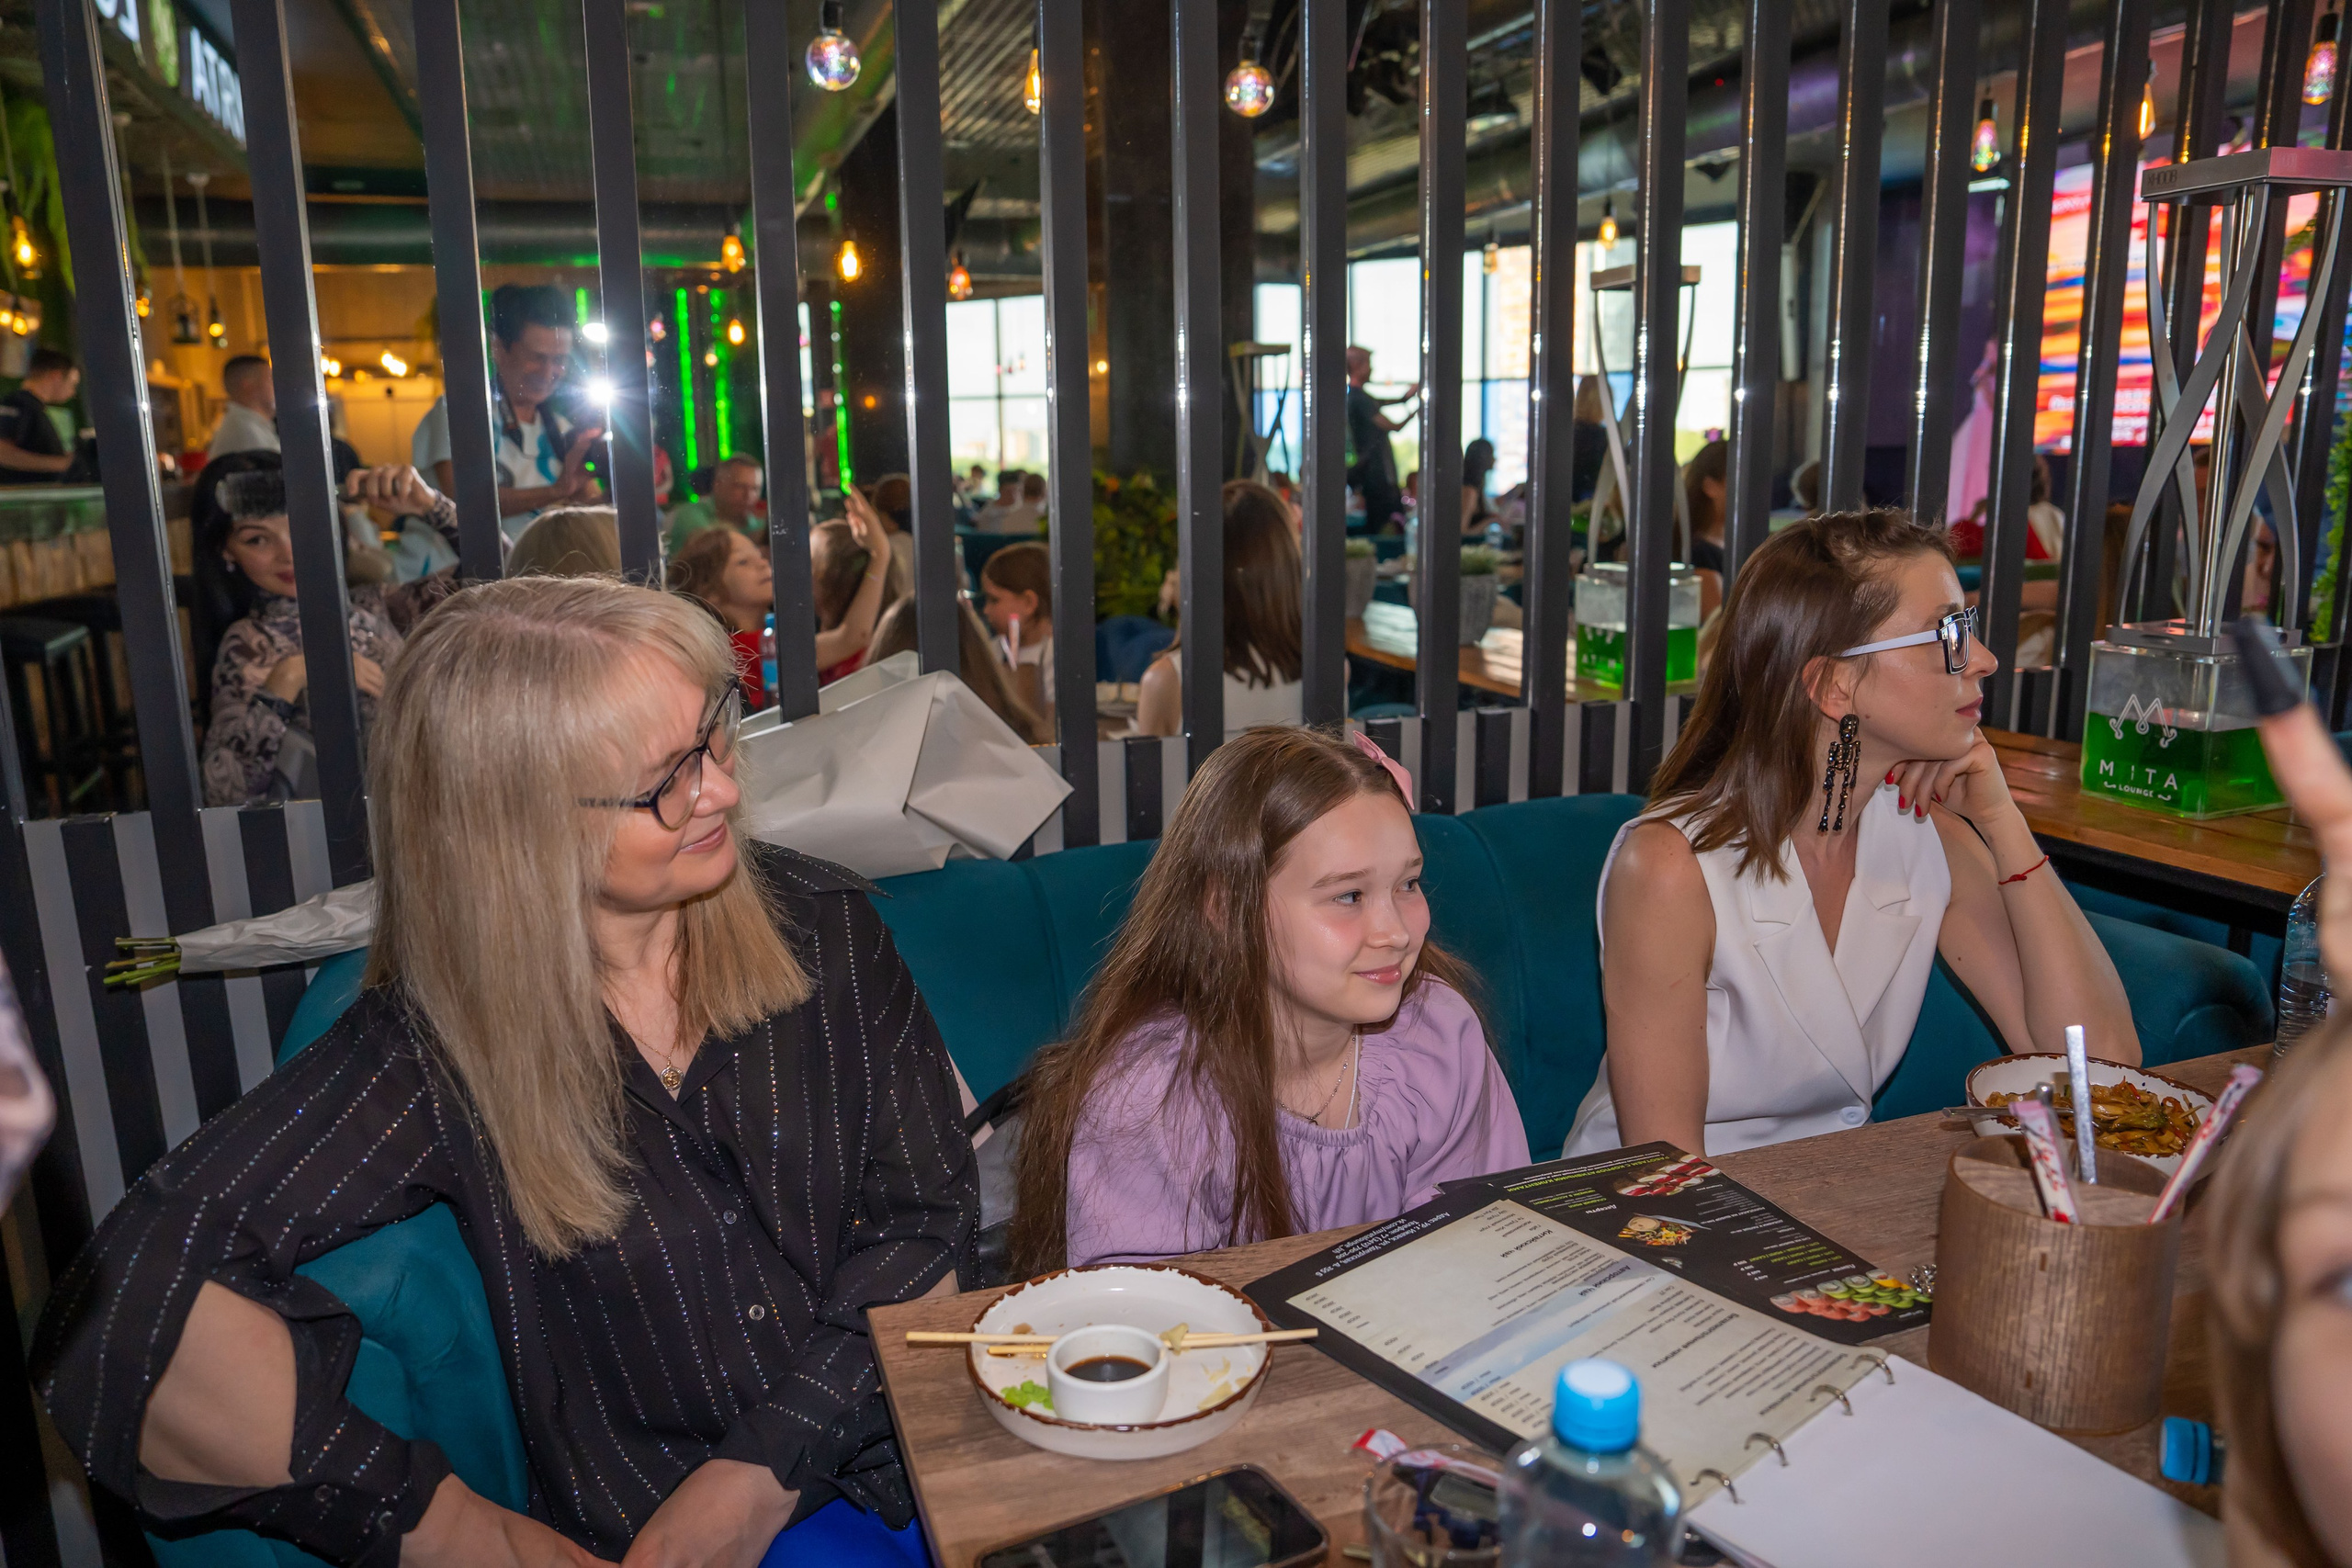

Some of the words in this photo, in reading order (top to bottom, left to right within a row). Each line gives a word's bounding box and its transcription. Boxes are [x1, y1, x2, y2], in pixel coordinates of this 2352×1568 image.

[2118, 784, 2154, 798] LOUNGE
[1632, 1156, 1670, 1166] РАБОТАЕМ
[1555, 1166, 1625, 1182] КОРПОРАТИВНЫМИ
[1507, 1179, 1554, 1191] КЛИЕНТАМИ
[1586, 1205, 1617, 1214] Десерты
[1428, 1212, 1450, 1223] Адрес:
[1361, 1236, 1382, 1247] (3412)
[1388, 1228, 1416, 1242] Ижевск,
[1514, 1230, 1553, 1251] Китайский
[1335, 1246, 1363, 1259] 790-200
[1340, 1245, 1381, 1265] Удмуртская,
[1501, 1249, 1515, 1258] чай
[1592, 1265, 1631, 1289] Авторский
[1681, 1313, 1738, 1349] Безалкогольные
[1651, 1348, 1683, 1369] напитки
